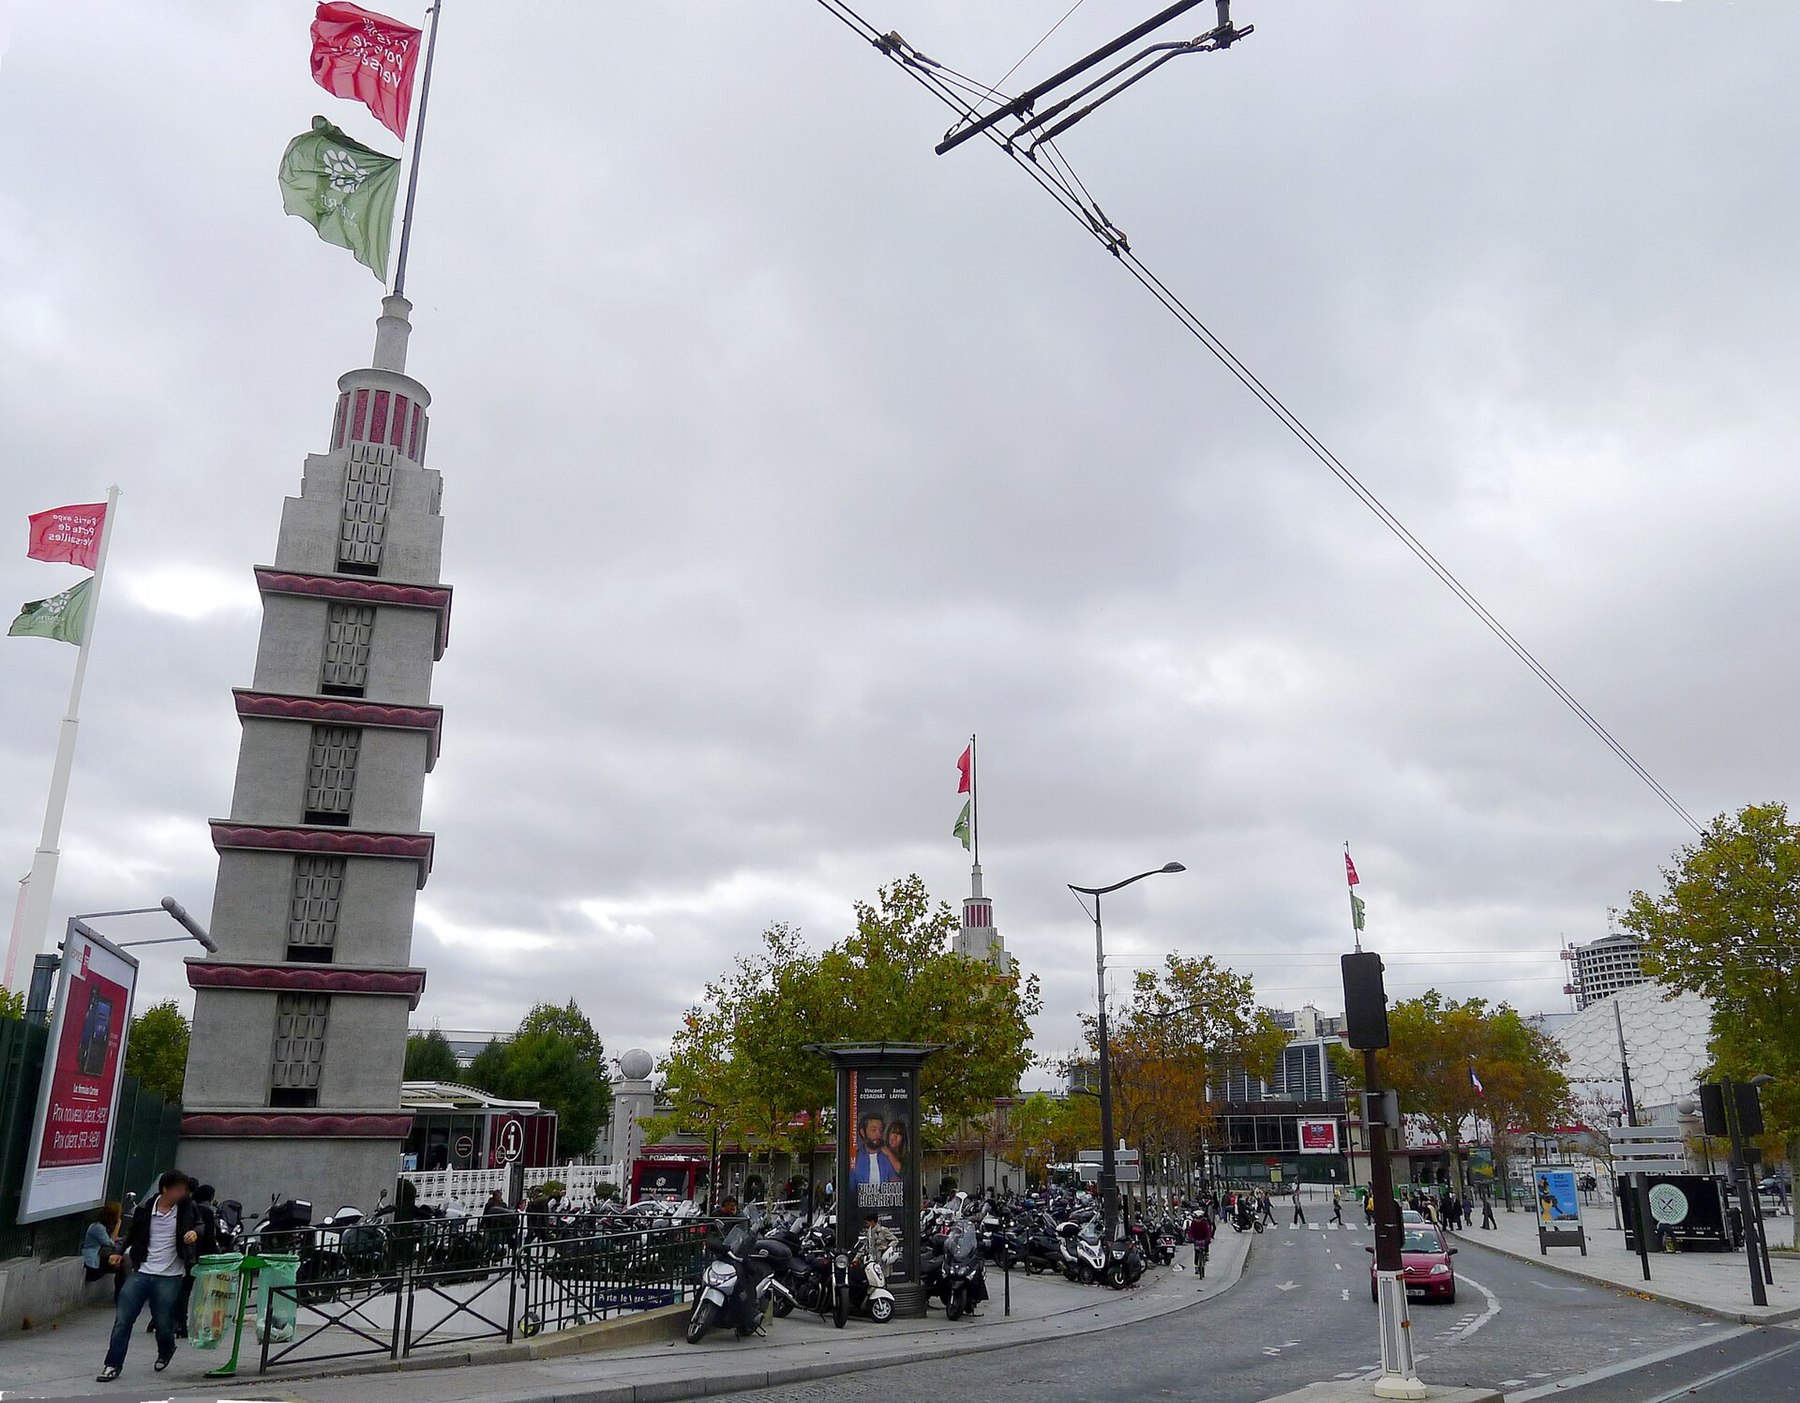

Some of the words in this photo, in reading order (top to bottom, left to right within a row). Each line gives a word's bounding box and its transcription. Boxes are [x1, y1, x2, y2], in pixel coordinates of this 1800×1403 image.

[53, 1103, 64, 1121] Prix
[53, 1131, 65, 1149] Prix
[857, 1193, 904, 1207] CIGARETTE
